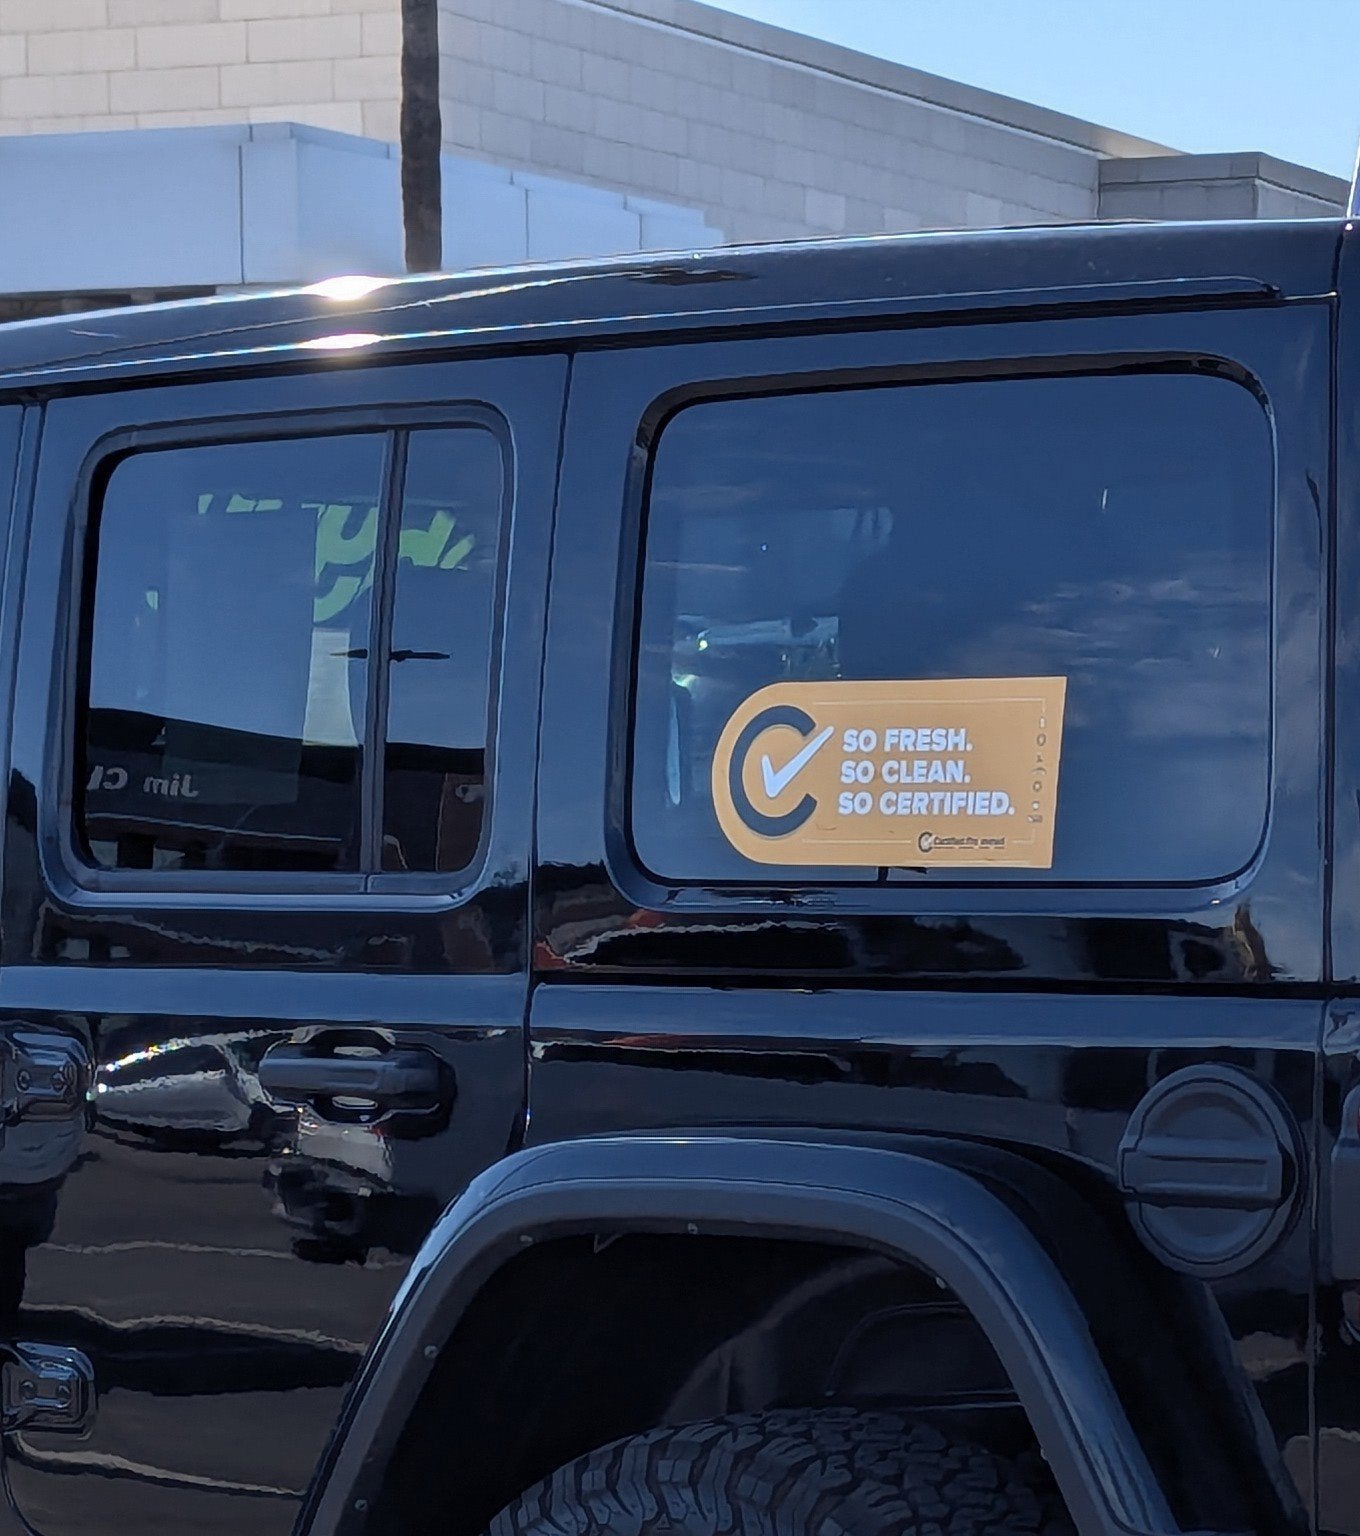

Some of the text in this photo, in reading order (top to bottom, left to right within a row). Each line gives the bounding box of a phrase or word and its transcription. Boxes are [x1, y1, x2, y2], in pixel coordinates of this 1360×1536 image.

[842, 727, 973, 752] SO FRESH.
[840, 760, 971, 784] SO CLEAN.
[838, 791, 1015, 816] SO CERTIFIED.
